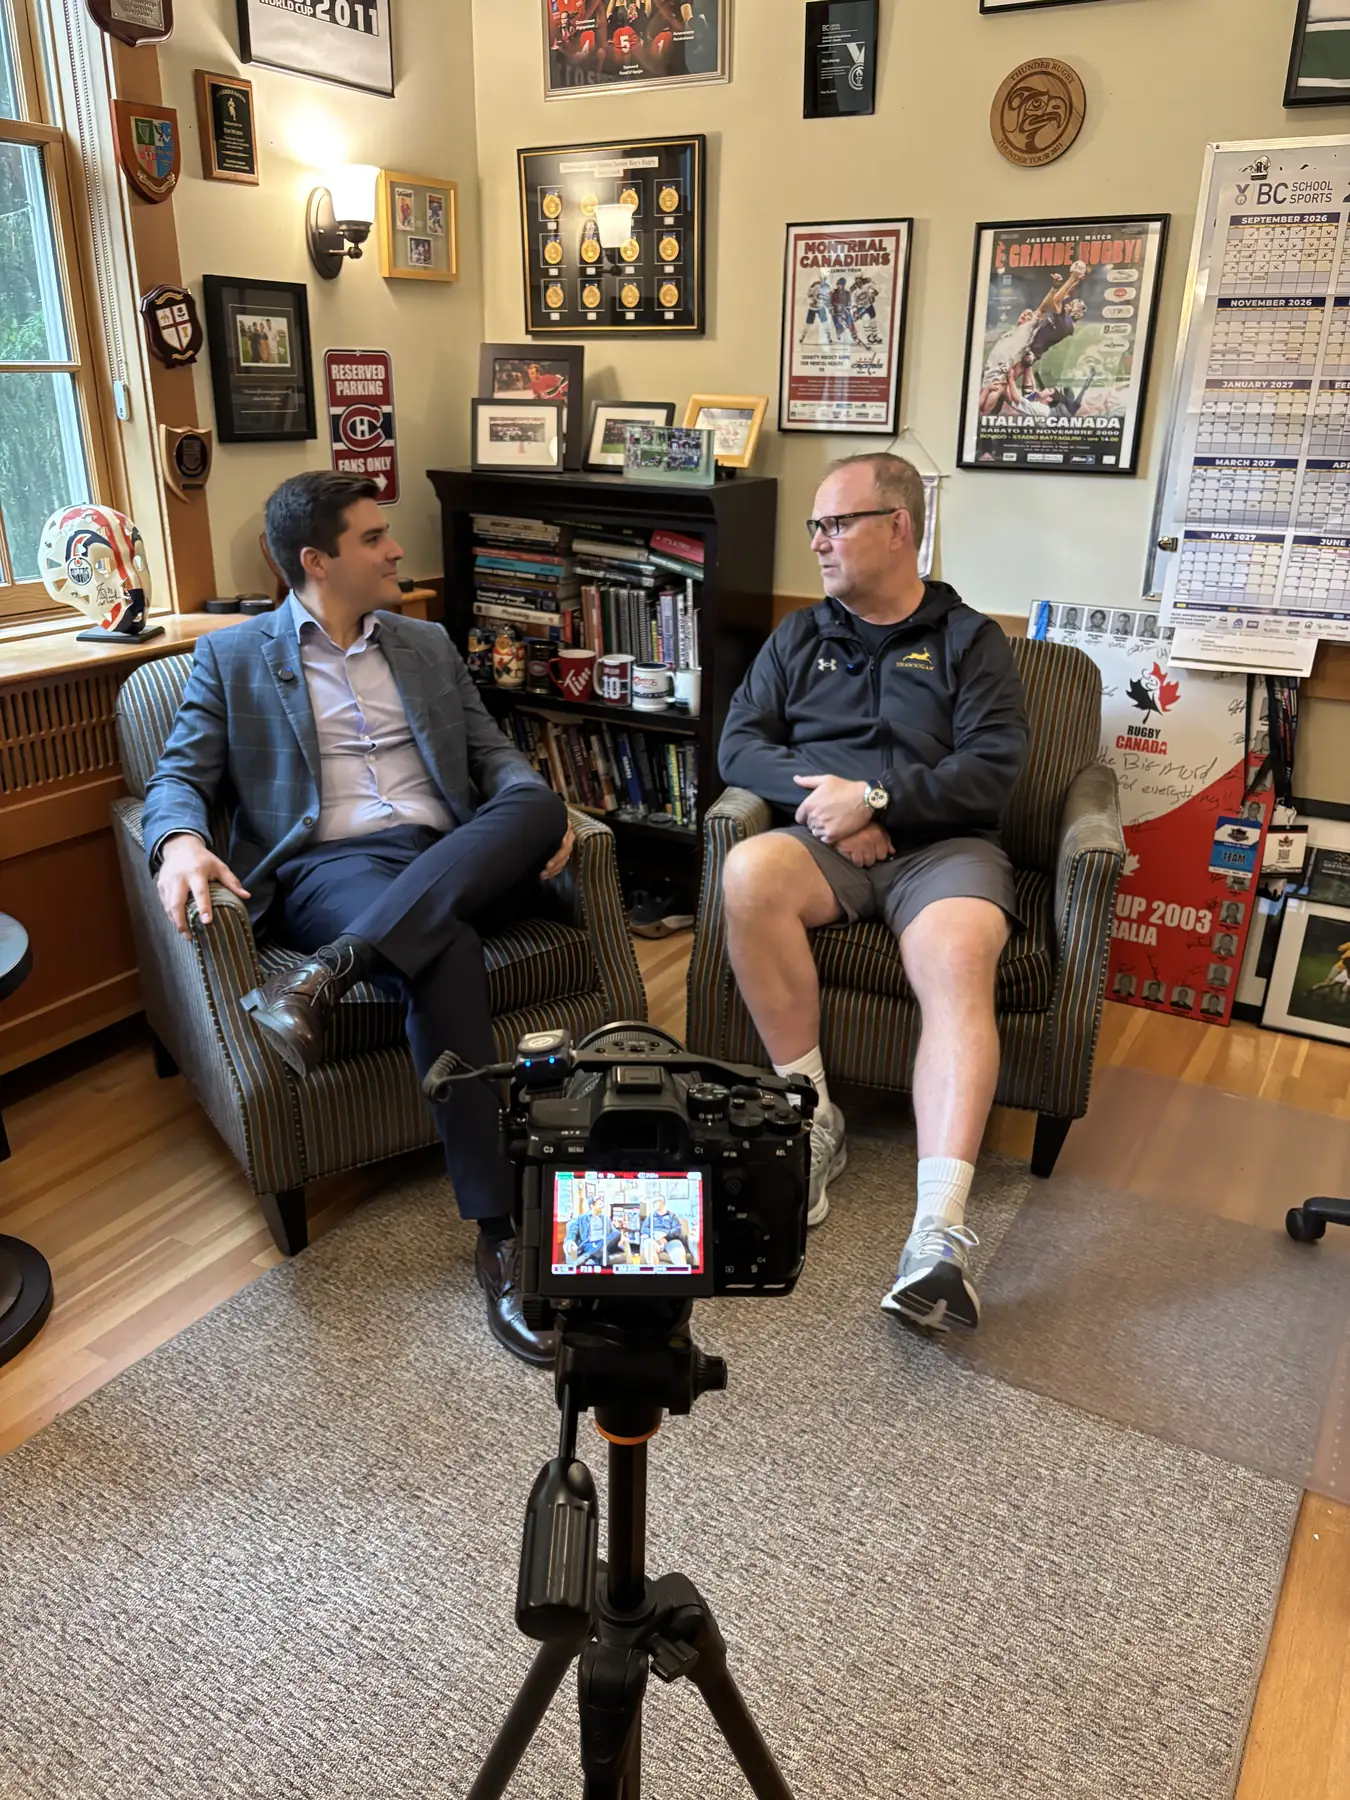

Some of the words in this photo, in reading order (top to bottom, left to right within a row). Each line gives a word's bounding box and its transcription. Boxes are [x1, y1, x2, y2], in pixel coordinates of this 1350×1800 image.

[296, 4, 314, 16] CUP
[315, 0, 379, 36] 2011
[619, 35, 631, 54] 5
[1010, 61, 1051, 81] THUNDER
[1051, 62, 1075, 84] RUGBY
[999, 139, 1028, 164] THUNDER
[1028, 152, 1051, 164] TOUR
[1256, 182, 1289, 205] BC
[1291, 180, 1334, 192] SCHOOL
[1289, 192, 1333, 204] SPORTS
[1241, 216, 1301, 224] SEPTEMBER
[1303, 214, 1328, 223] 2026
[803, 239, 888, 255] MONTREAL
[1009, 242, 1074, 268] GRANDE
[1078, 239, 1143, 265] RUGBY!
[799, 252, 891, 269] CANADIENS
[1230, 299, 1286, 307] NOVEMBER
[330, 364, 386, 380] RESERVED
[335, 380, 384, 396] PARKING
[981, 415, 1035, 427] ITALIA
[1046, 416, 1121, 429] CANADA
[337, 458, 365, 473] FANS
[366, 456, 392, 472] ONLY
[1211, 532, 1231, 540] MAY
[1233, 533, 1256, 541] 2027
[895, 661, 936, 672] SHAWNIGAN
[563, 667, 592, 697] Tim
[602, 675, 621, 700] 10
[1127, 725, 1162, 740] RUGBY
[1115, 735, 1168, 755] CANADA
[1223, 851, 1246, 863] TEAM
[1114, 893, 1147, 920] UP
[1148, 900, 1213, 934] 2003
